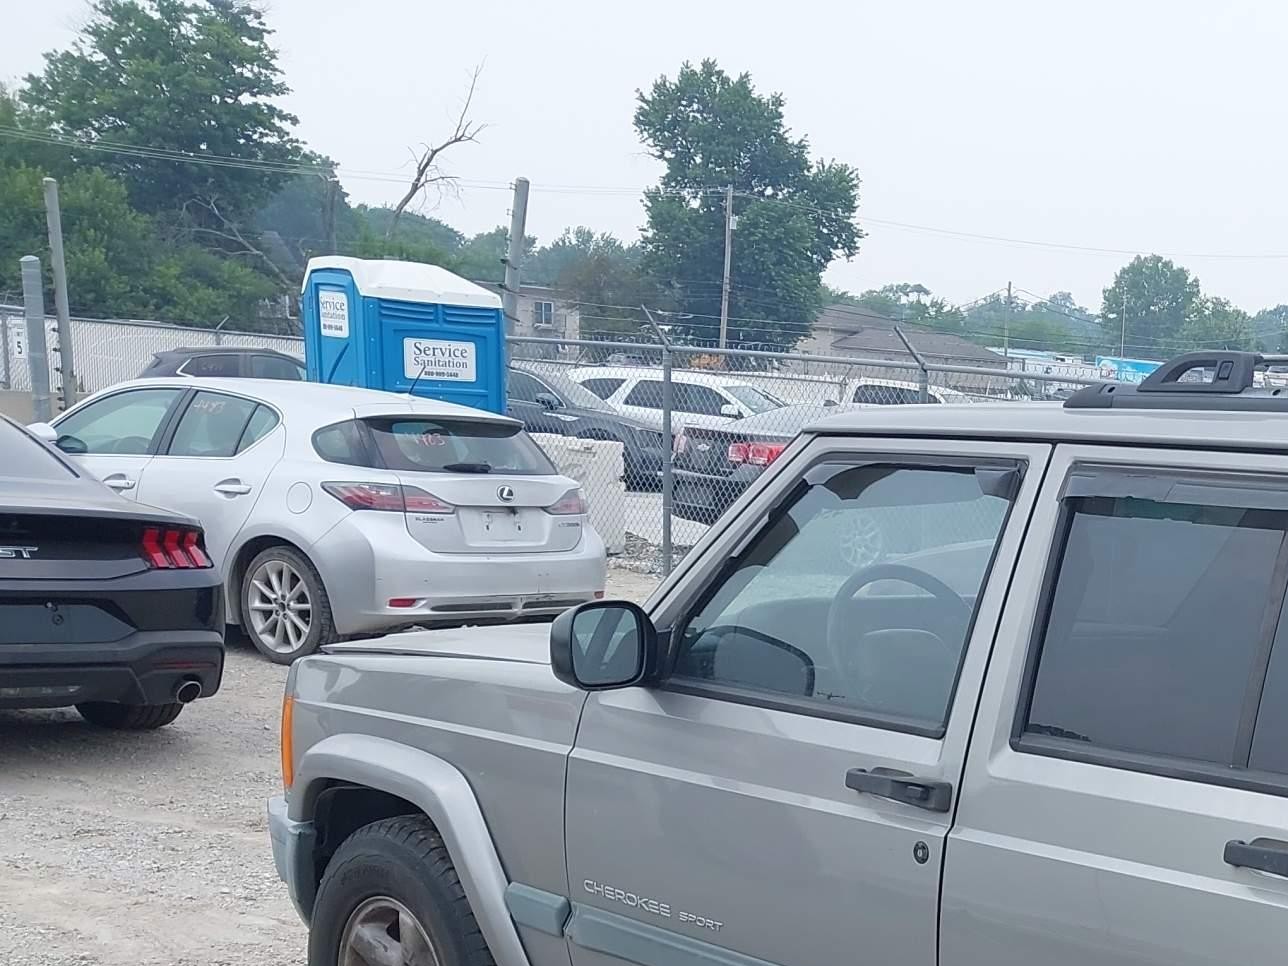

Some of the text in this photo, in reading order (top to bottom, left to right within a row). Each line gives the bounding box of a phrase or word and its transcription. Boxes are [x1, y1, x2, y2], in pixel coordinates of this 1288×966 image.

[413, 341, 468, 359] Service
[413, 356, 468, 369] Sanitation
[583, 879, 724, 932] CHEROKEE SPORT
